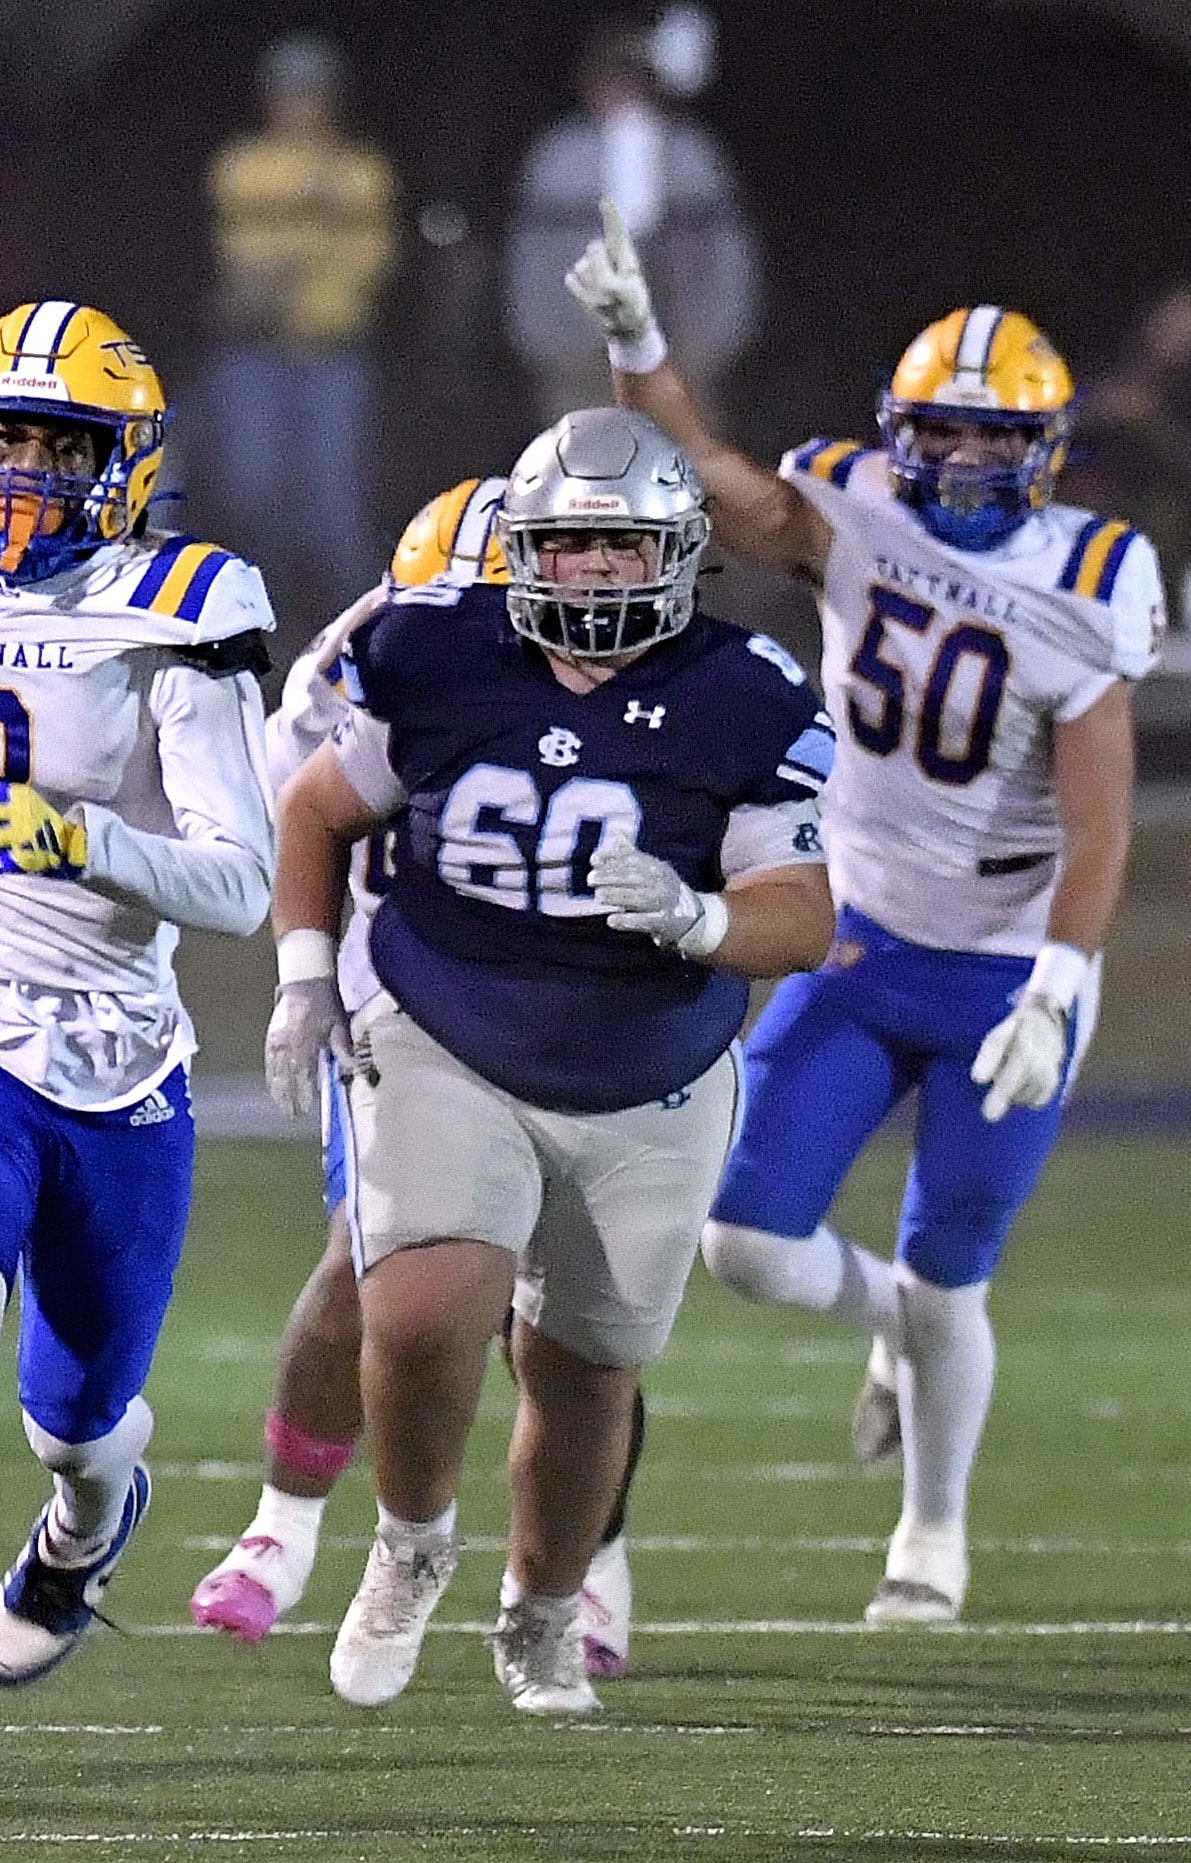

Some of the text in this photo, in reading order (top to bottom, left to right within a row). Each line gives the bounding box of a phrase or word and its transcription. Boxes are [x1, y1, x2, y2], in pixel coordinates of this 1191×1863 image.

[2, 376, 57, 389] Riddell
[847, 584, 1010, 786] 50
[437, 761, 641, 919] 60
